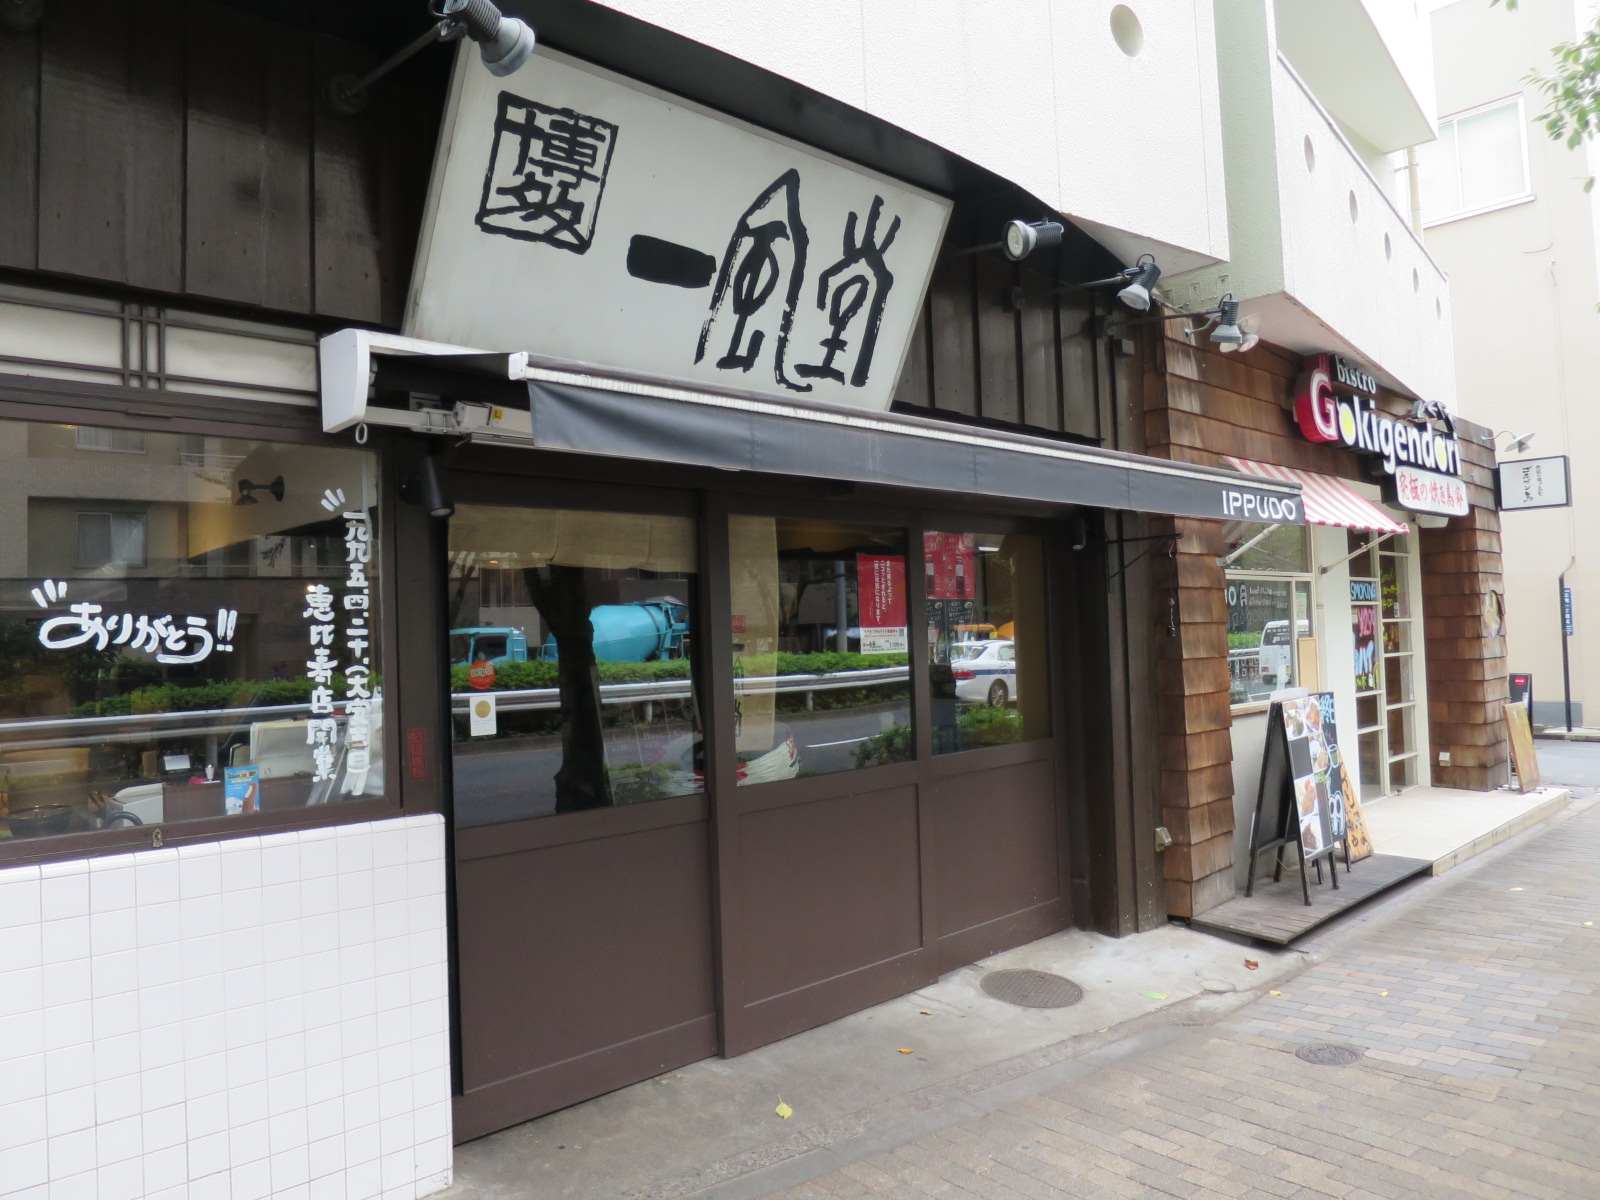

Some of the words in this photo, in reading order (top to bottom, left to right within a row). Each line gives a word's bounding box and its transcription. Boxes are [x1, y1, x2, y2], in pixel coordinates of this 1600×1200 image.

[475, 90, 619, 255] 博多
[626, 167, 901, 392] 一風堂
[1310, 368, 1463, 476] Gokigendori
[1334, 355, 1376, 395] bistro
[1221, 490, 1296, 521] IPPUDO
[1351, 582, 1376, 601] SMOKING
[303, 584, 338, 783] 恵比寿店開業
